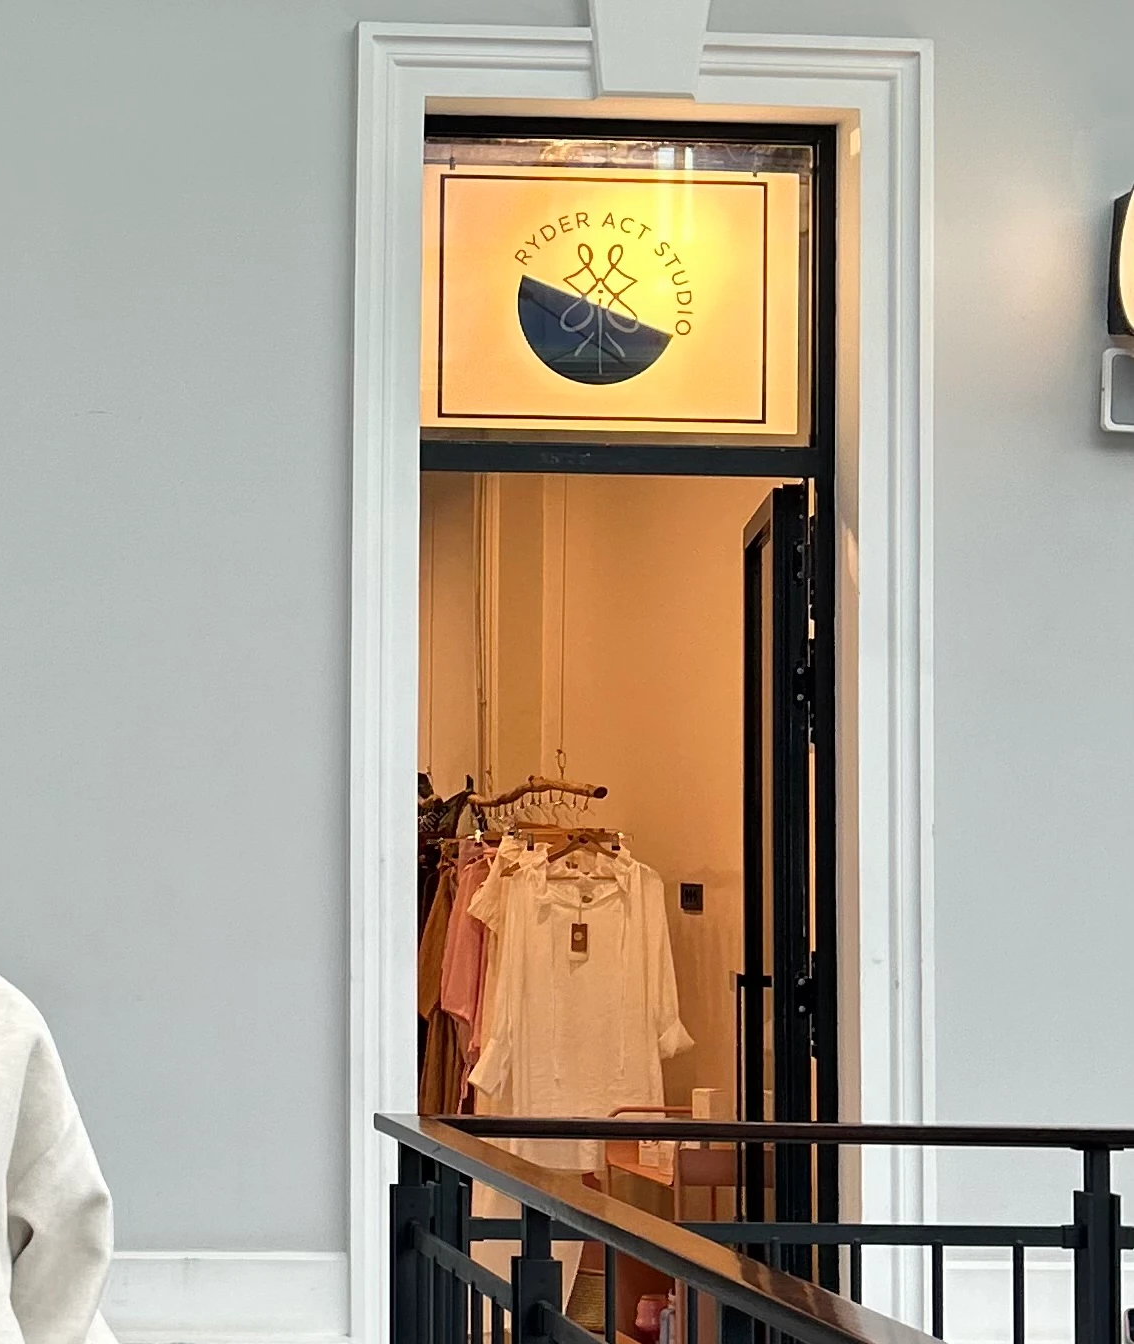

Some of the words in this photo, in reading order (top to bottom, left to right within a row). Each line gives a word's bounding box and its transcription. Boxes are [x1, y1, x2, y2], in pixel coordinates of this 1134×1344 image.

[514, 212, 590, 266] RYDER
[601, 212, 652, 240] ACT
[654, 241, 694, 336] STUDIO
